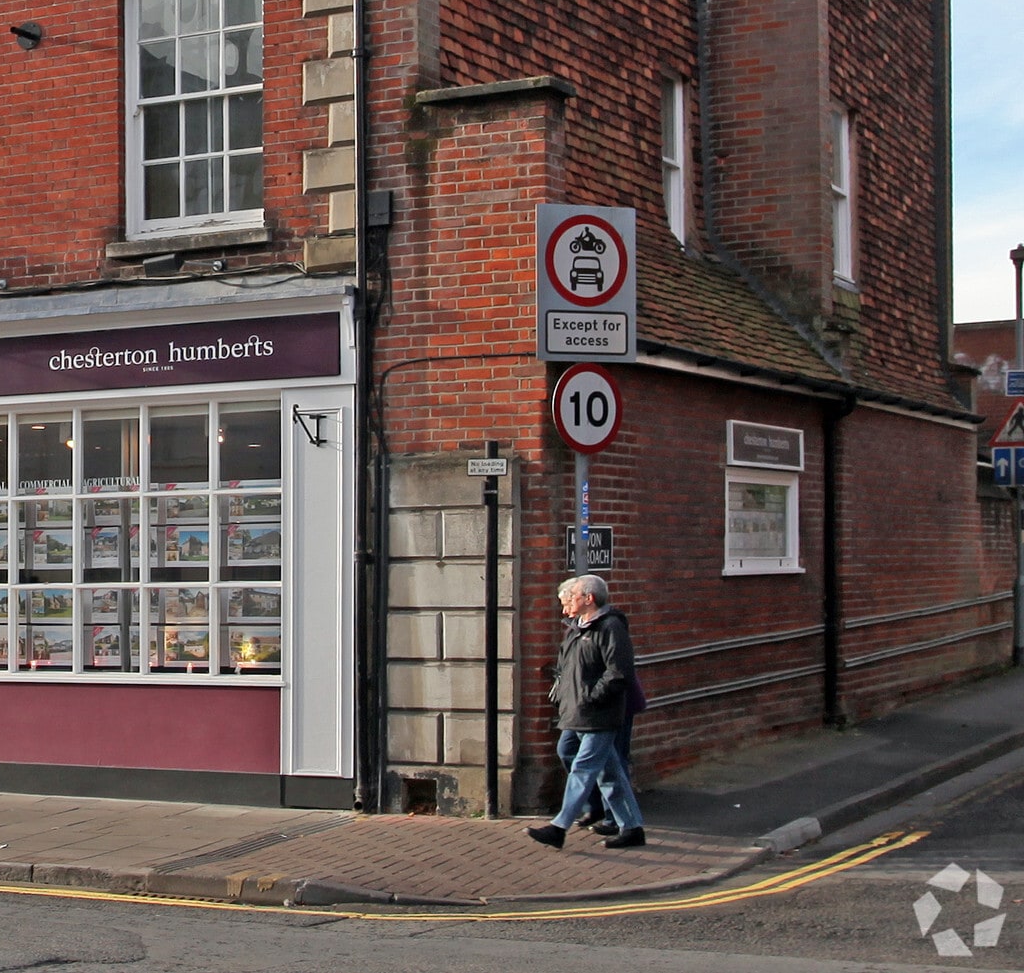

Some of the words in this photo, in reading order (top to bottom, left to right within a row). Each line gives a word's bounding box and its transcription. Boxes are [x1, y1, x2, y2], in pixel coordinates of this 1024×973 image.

[553, 318, 598, 332] Except
[603, 320, 621, 331] for
[565, 336, 609, 346] access
[49, 347, 158, 371] chesterton
[168, 335, 274, 363] humberts
[569, 391, 609, 427] 10
[19, 479, 72, 490] COMMERCIAL
[83, 476, 141, 488] AGRICULTURAL
